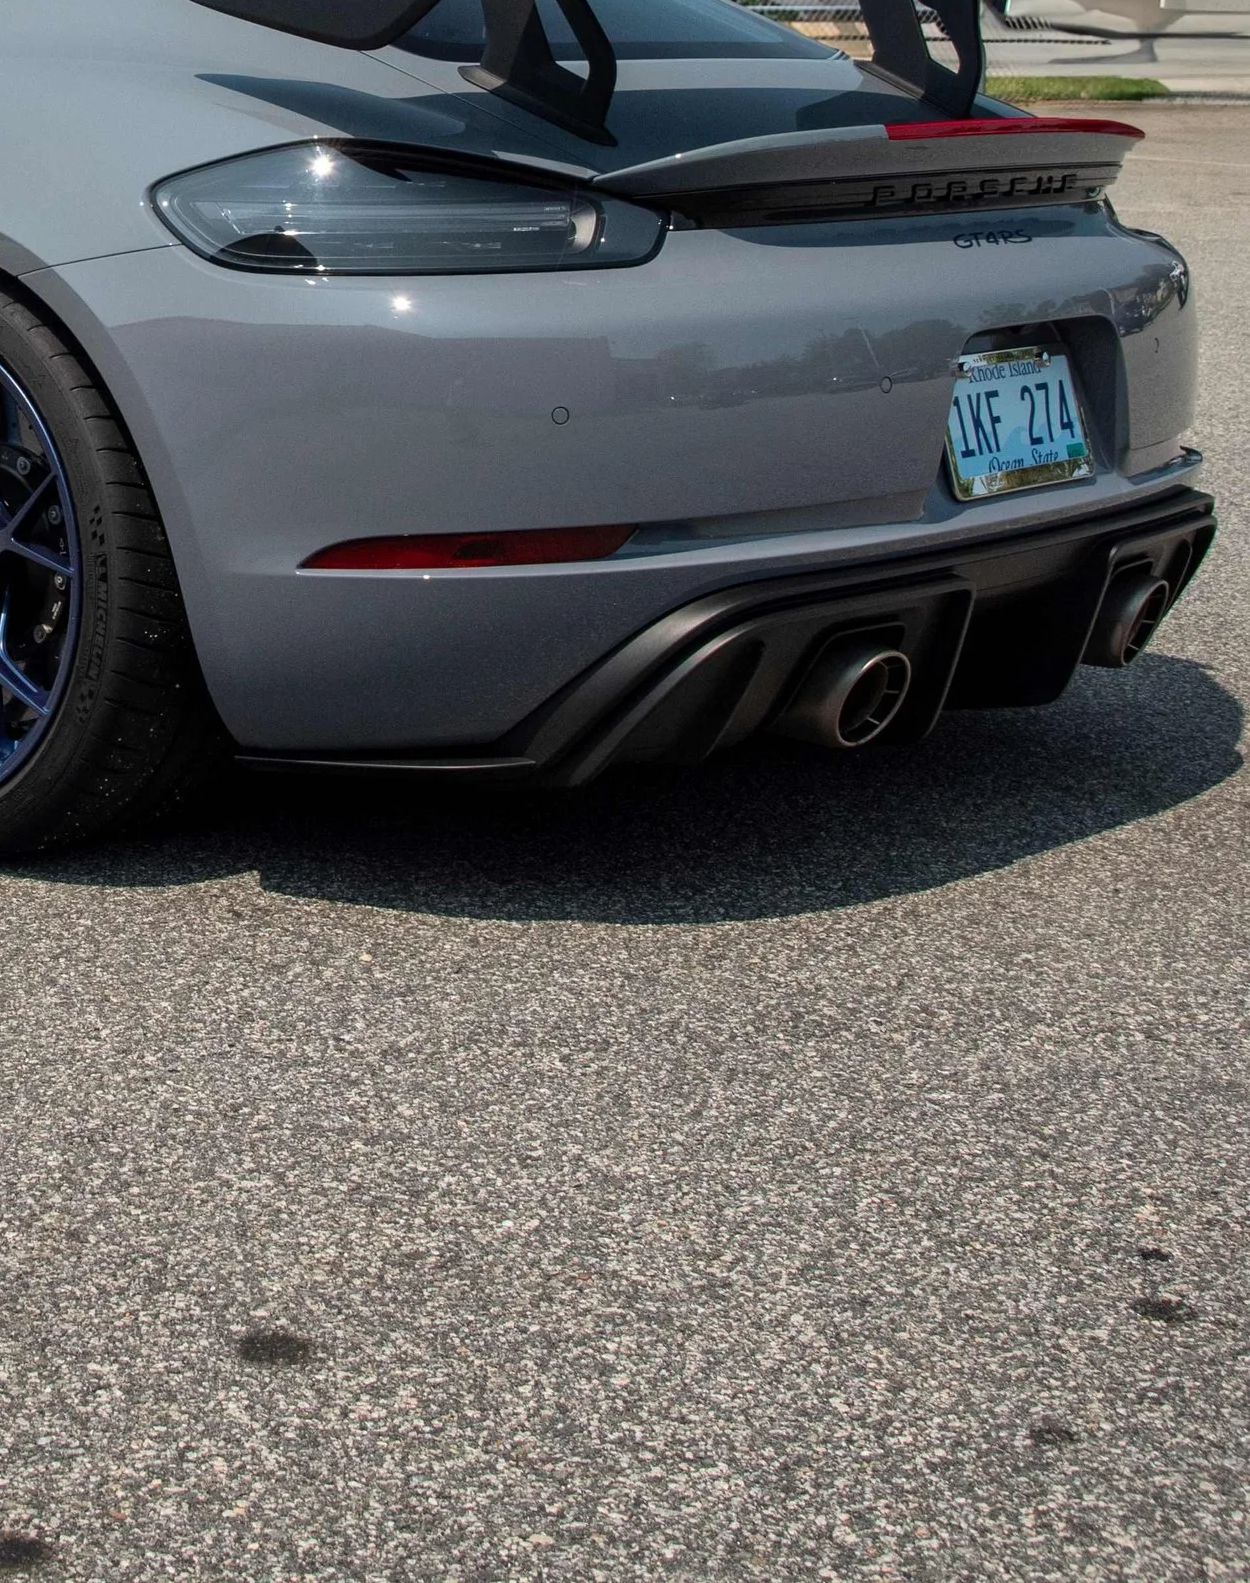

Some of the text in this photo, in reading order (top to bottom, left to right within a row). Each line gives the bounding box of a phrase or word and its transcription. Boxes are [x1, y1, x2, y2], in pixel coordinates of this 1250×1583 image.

[865, 173, 1079, 207] PORSCHE
[953, 379, 1075, 458] 1KF 274
[86, 581, 108, 680] MICHELIN
